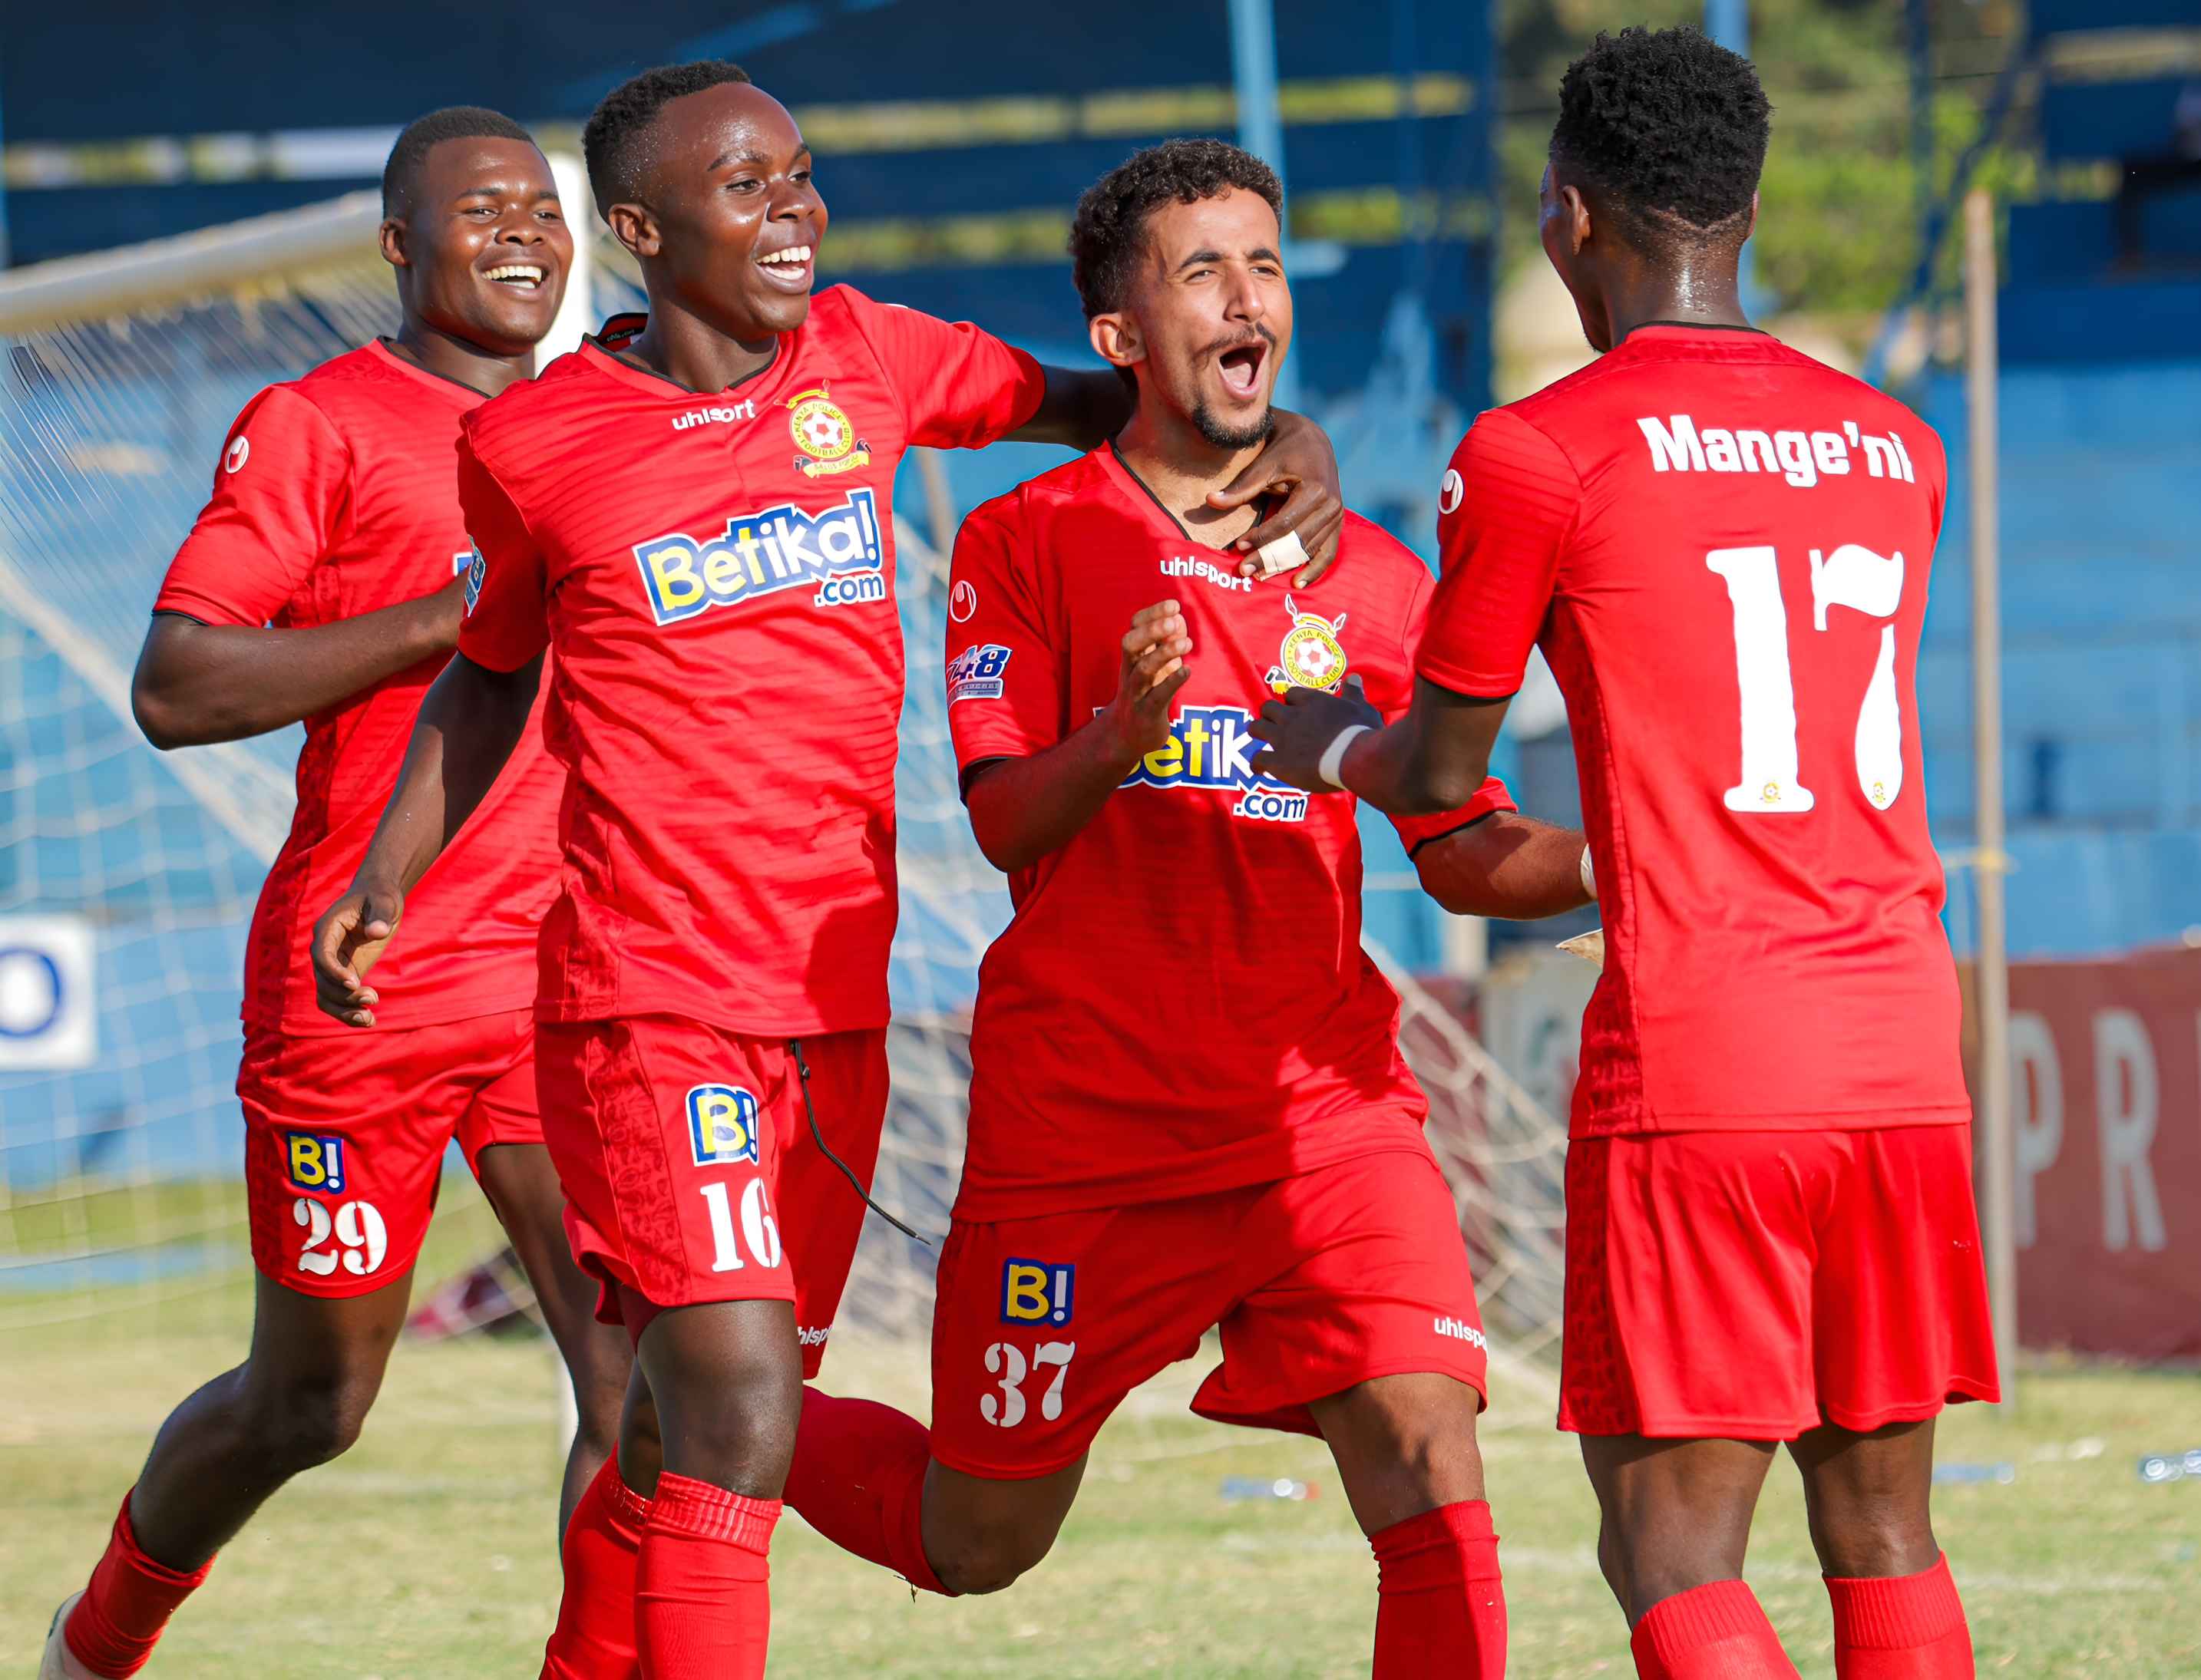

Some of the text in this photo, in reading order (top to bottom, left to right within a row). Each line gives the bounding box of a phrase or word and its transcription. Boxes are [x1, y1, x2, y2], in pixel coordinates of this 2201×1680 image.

[671, 399, 755, 430] uhlsort
[795, 403, 845, 432] KENYA POLICE
[1637, 414, 1915, 487] Mange'ni
[647, 500, 877, 612] Betika!
[1160, 556, 1253, 592] uhlsport
[818, 574, 883, 602] .com
[1290, 630, 1340, 658] KENYA POLICE
[1321, 665, 1340, 684] CLUB
[1706, 544, 1904, 812] 17
[1129, 718, 1274, 781] etik
[1236, 794, 1307, 818] .com
[697, 1093, 757, 1155] B!
[2009, 1009, 2201, 1253] PR
[290, 1136, 340, 1189] B!
[293, 1198, 388, 1276] 29
[700, 1177, 782, 1272] 16
[1006, 1264, 1067, 1320] B!
[980, 1342, 1076, 1428] 37
